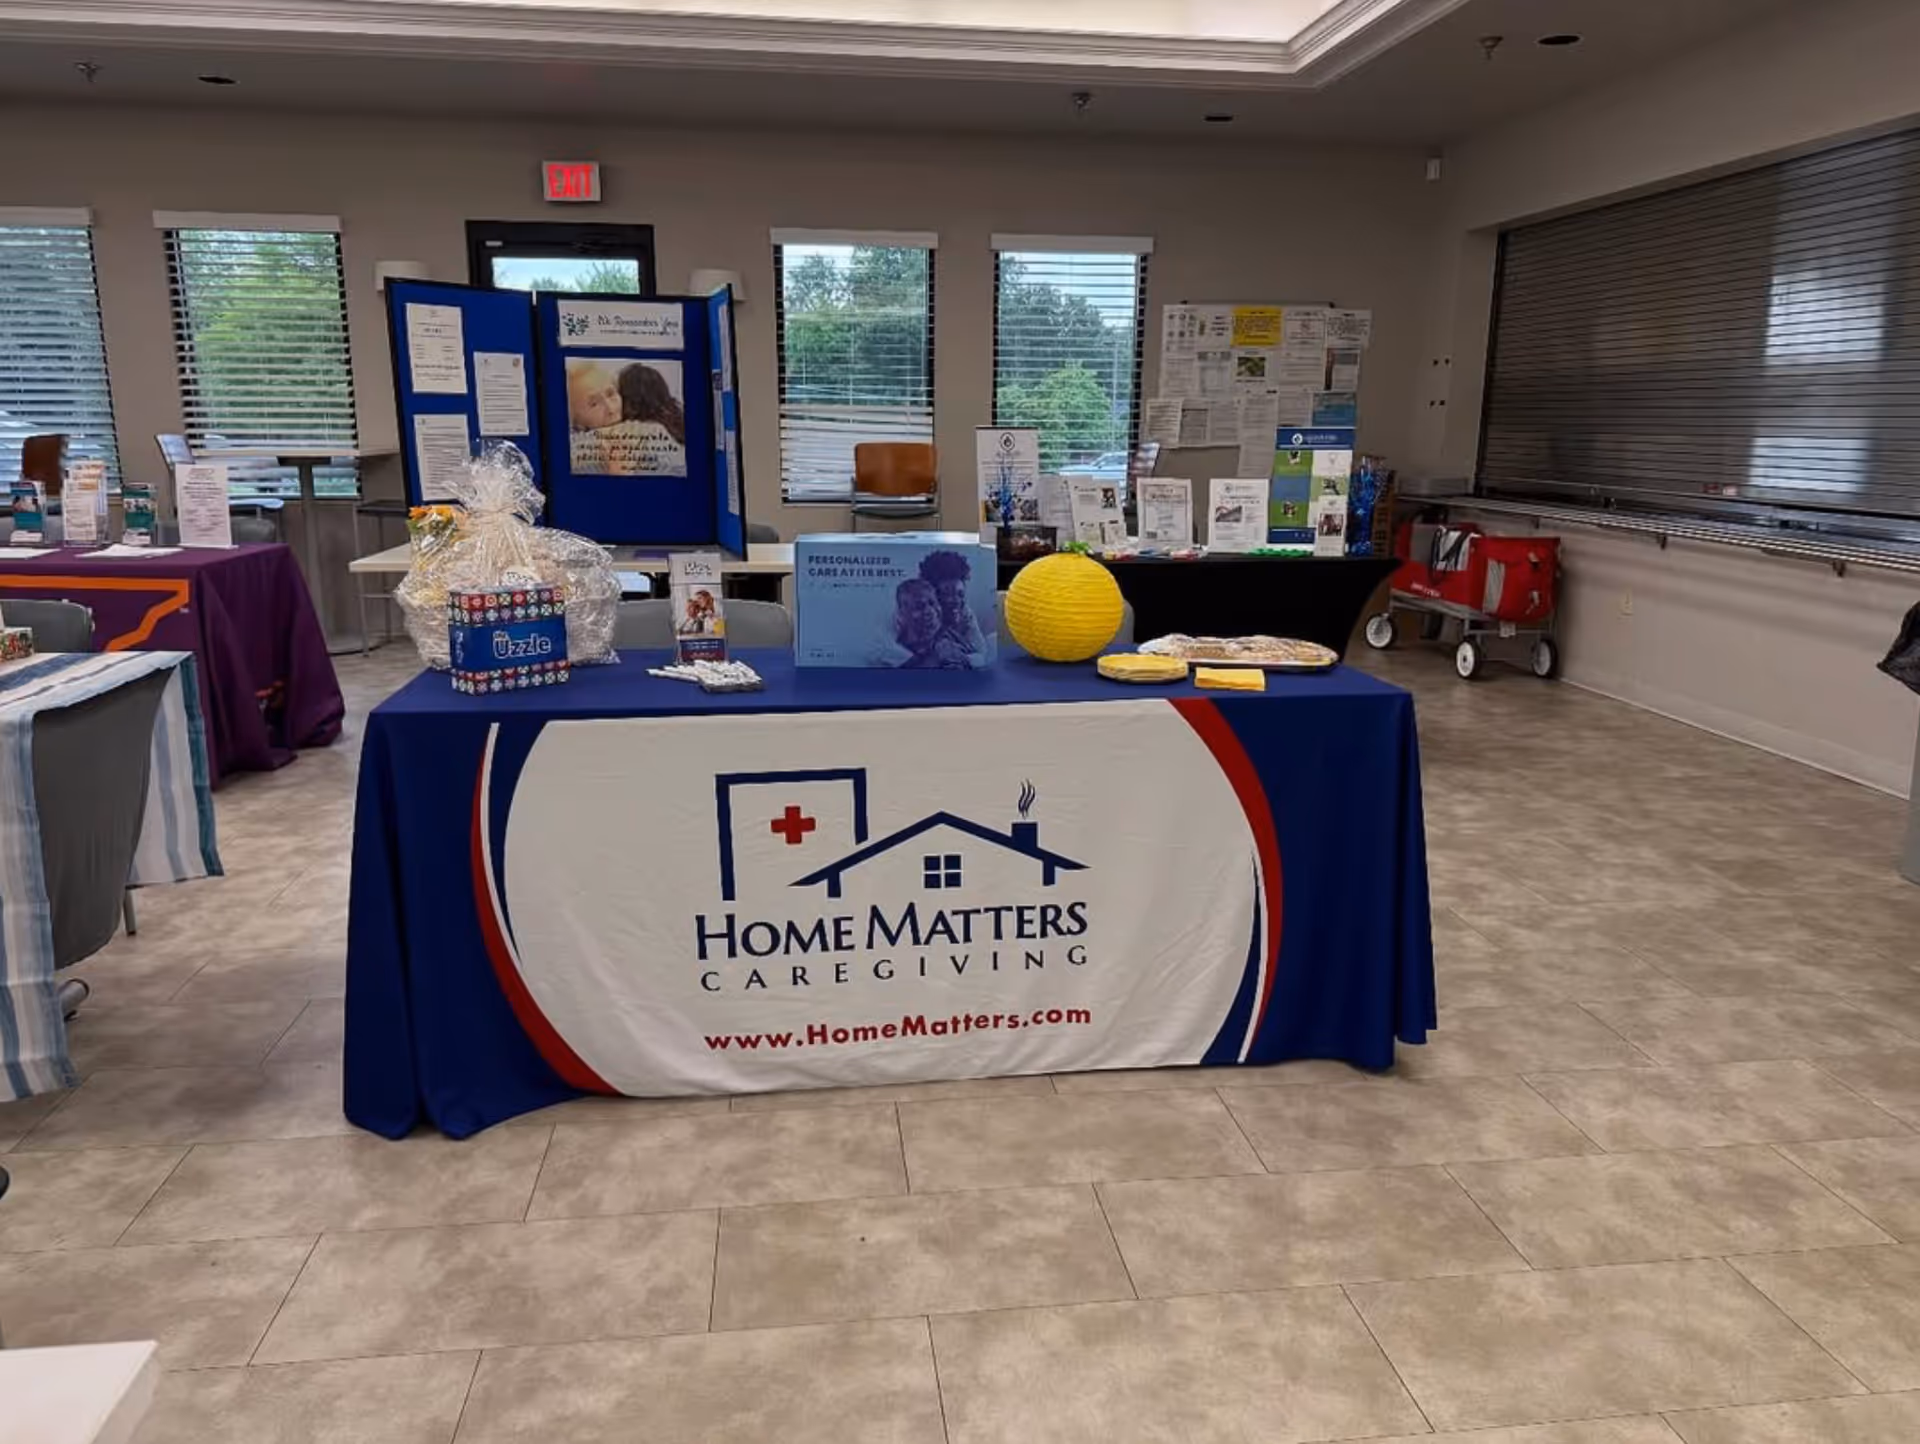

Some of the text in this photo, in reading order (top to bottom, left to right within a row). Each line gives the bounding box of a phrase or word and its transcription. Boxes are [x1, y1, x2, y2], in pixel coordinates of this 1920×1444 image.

[808, 555, 890, 565] PERSONALIZED
[808, 567, 838, 577] CARE
[493, 633, 552, 660] Uzzle
[701, 945, 1088, 991] CAREGIVING
[704, 1008, 1091, 1050] www.HomeMatters.com
